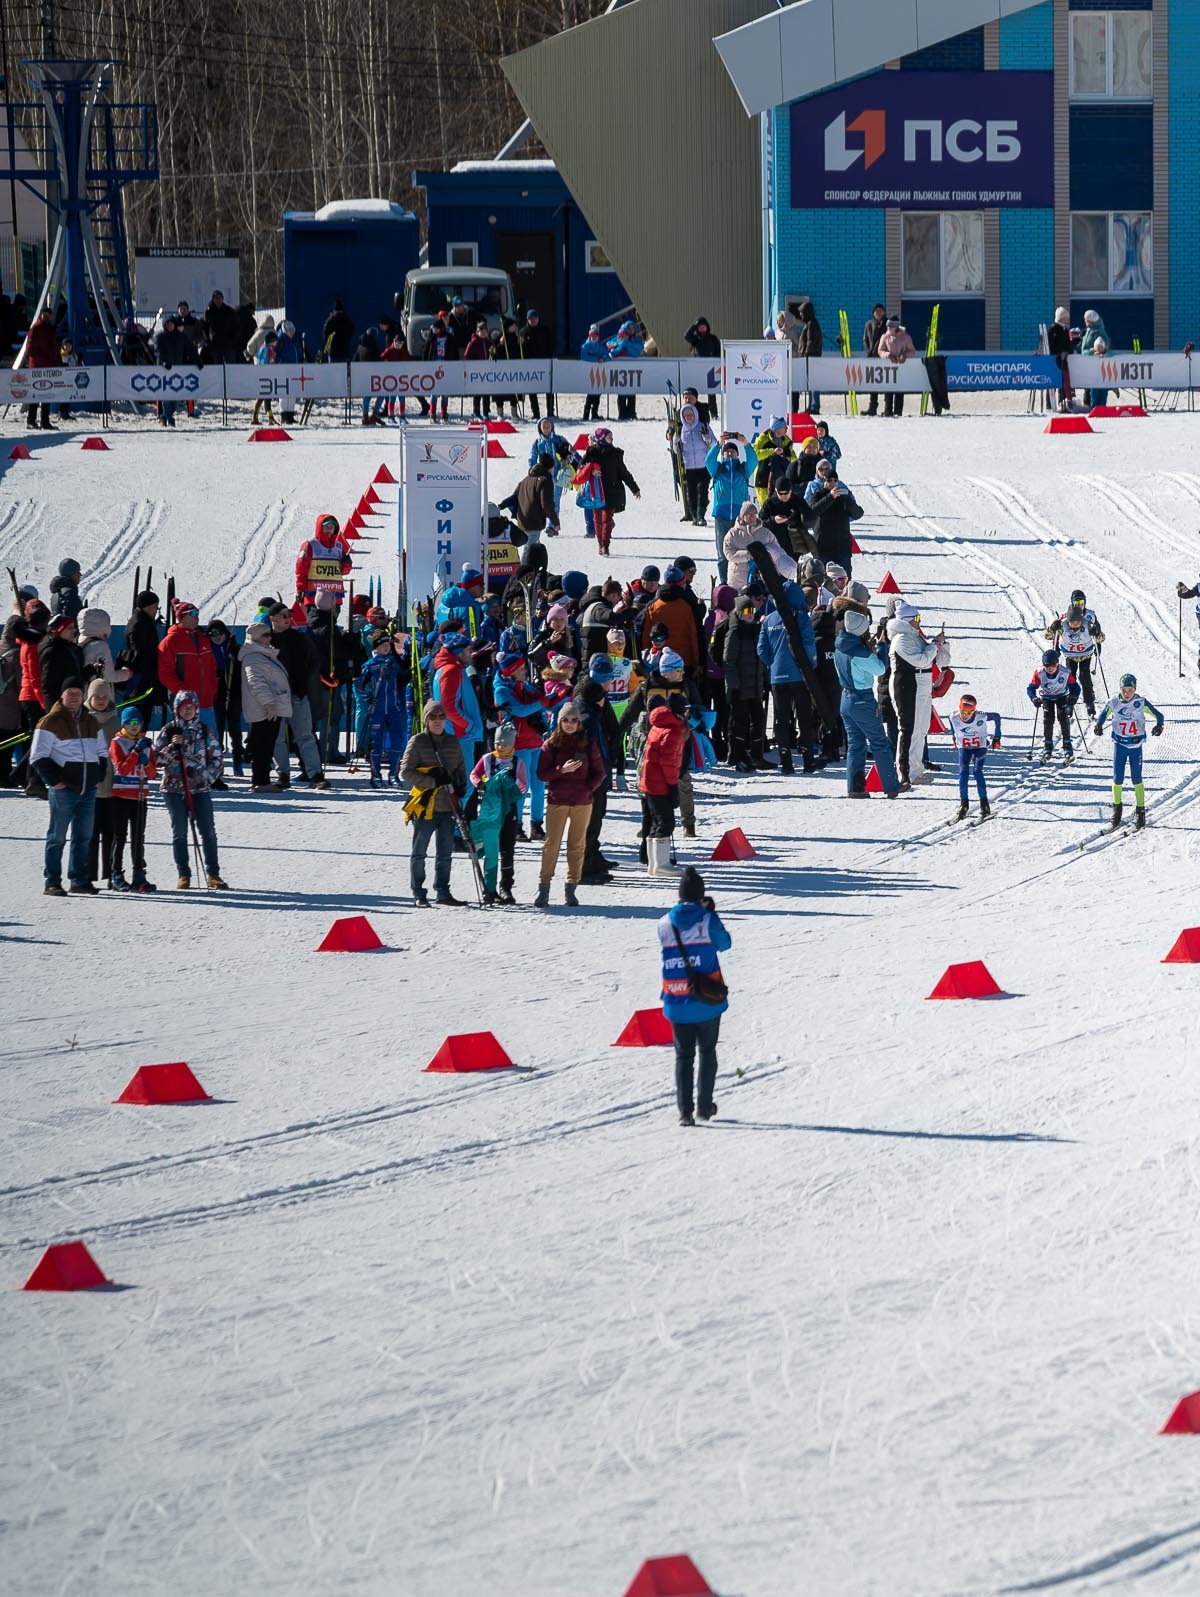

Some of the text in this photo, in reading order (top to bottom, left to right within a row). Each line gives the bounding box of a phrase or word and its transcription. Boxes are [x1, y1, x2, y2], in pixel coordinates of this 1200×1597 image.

[903, 119, 1021, 163] ПСБ
[825, 190, 1022, 202] СПОНСОР ФЕДЕРАЦИИ ЛЫЖНЫХ ГОНОК УДМУРТИИ
[149, 249, 226, 257] ИНФОРМАЦИЯ
[865, 366, 899, 384] ИЗТТ
[967, 363, 1032, 373] ТЕХНОПАРК
[1121, 362, 1154, 381] ИЗТТ
[131, 373, 200, 393] СОЮЗ
[370, 374, 436, 393] BOSCO
[470, 371, 546, 382] РУСКЛИМАТ
[609, 369, 643, 388] ИЗТТ
[947, 375, 1011, 385] РУСКЛИМАТ
[315, 564, 341, 577] СУДЬ
[1068, 643, 1085, 652] 76
[1119, 721, 1138, 736] 74
[962, 736, 981, 748] 65
[664, 955, 701, 970] ПРЕСА
